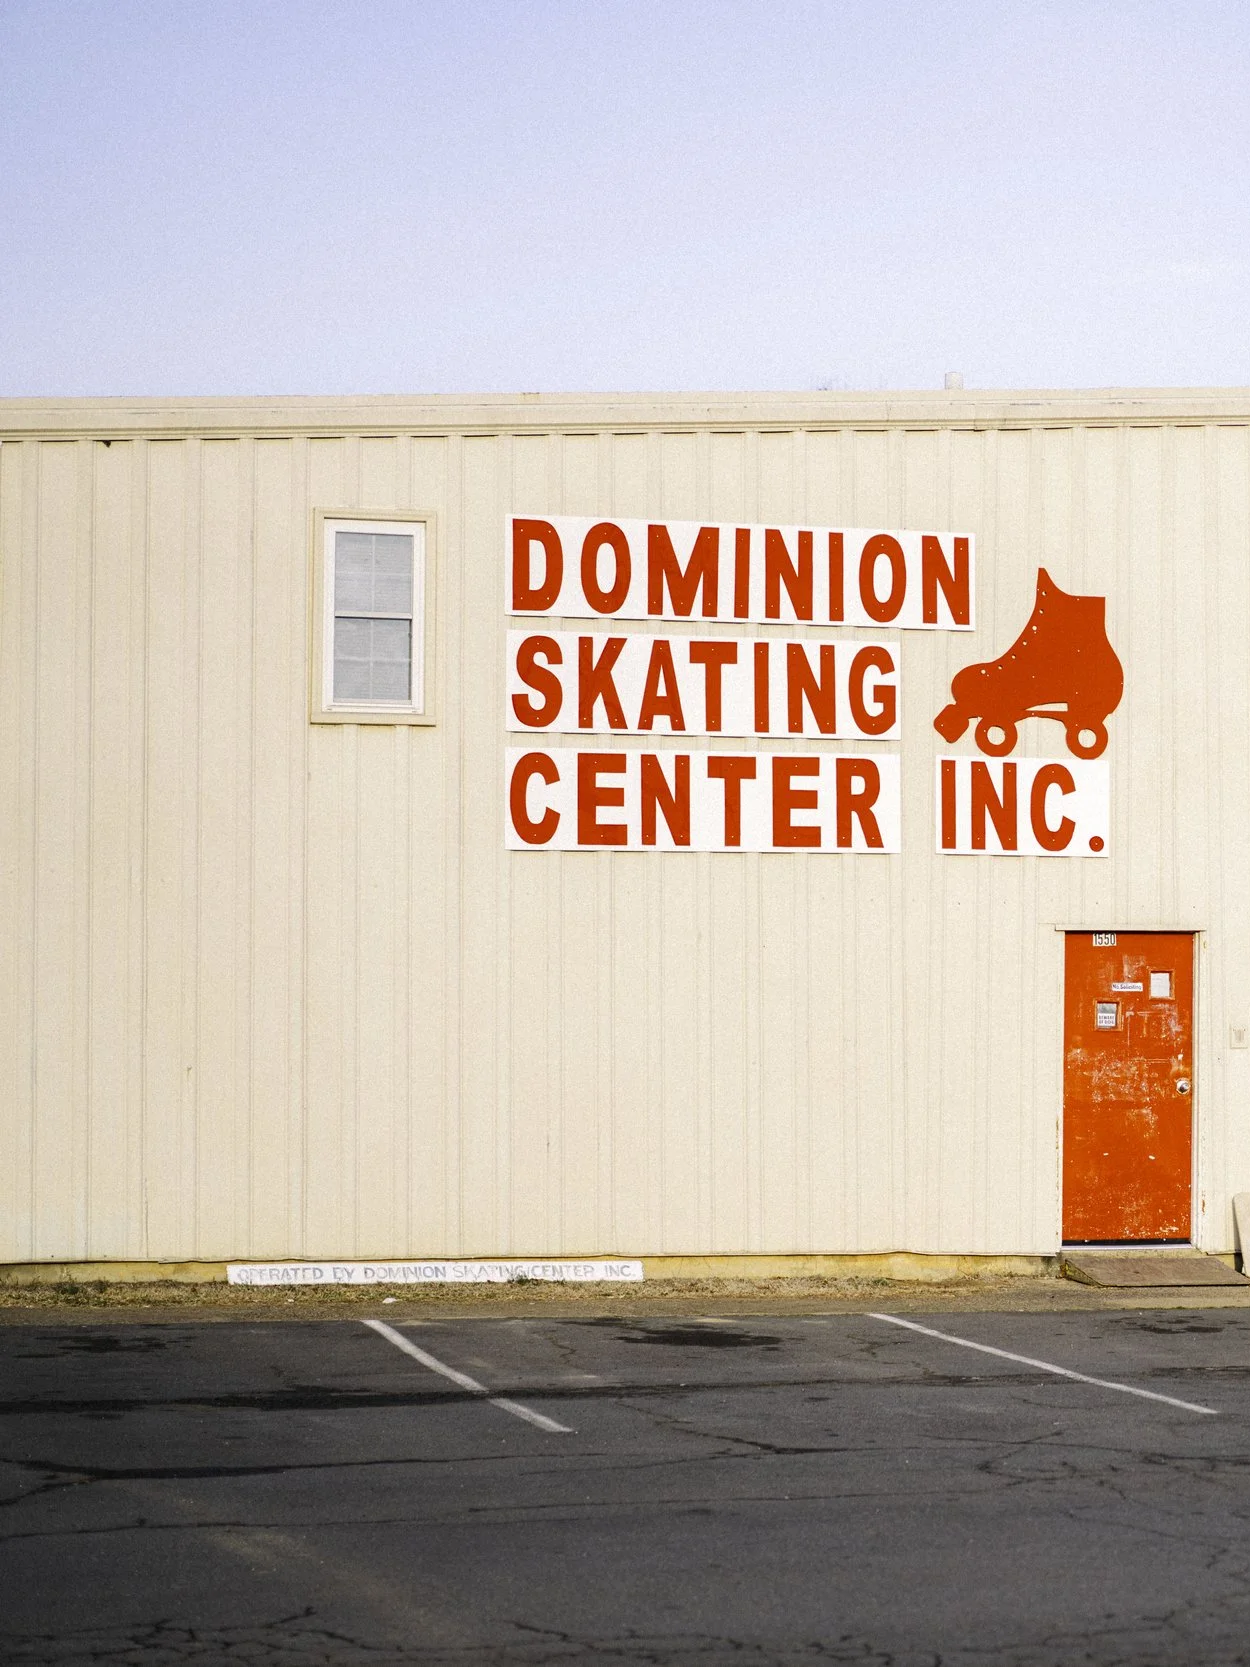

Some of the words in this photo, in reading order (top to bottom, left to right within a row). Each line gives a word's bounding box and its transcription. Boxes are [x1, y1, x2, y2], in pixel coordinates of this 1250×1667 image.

[512, 518, 969, 626] DOMINION
[511, 635, 896, 736] SKATING
[509, 752, 884, 848] CENTER
[941, 759, 1105, 853] INC.
[1094, 933, 1116, 945] 1550
[237, 1267, 324, 1283] OPERATED
[332, 1266, 356, 1281] BY
[364, 1265, 447, 1281] DOMINION
